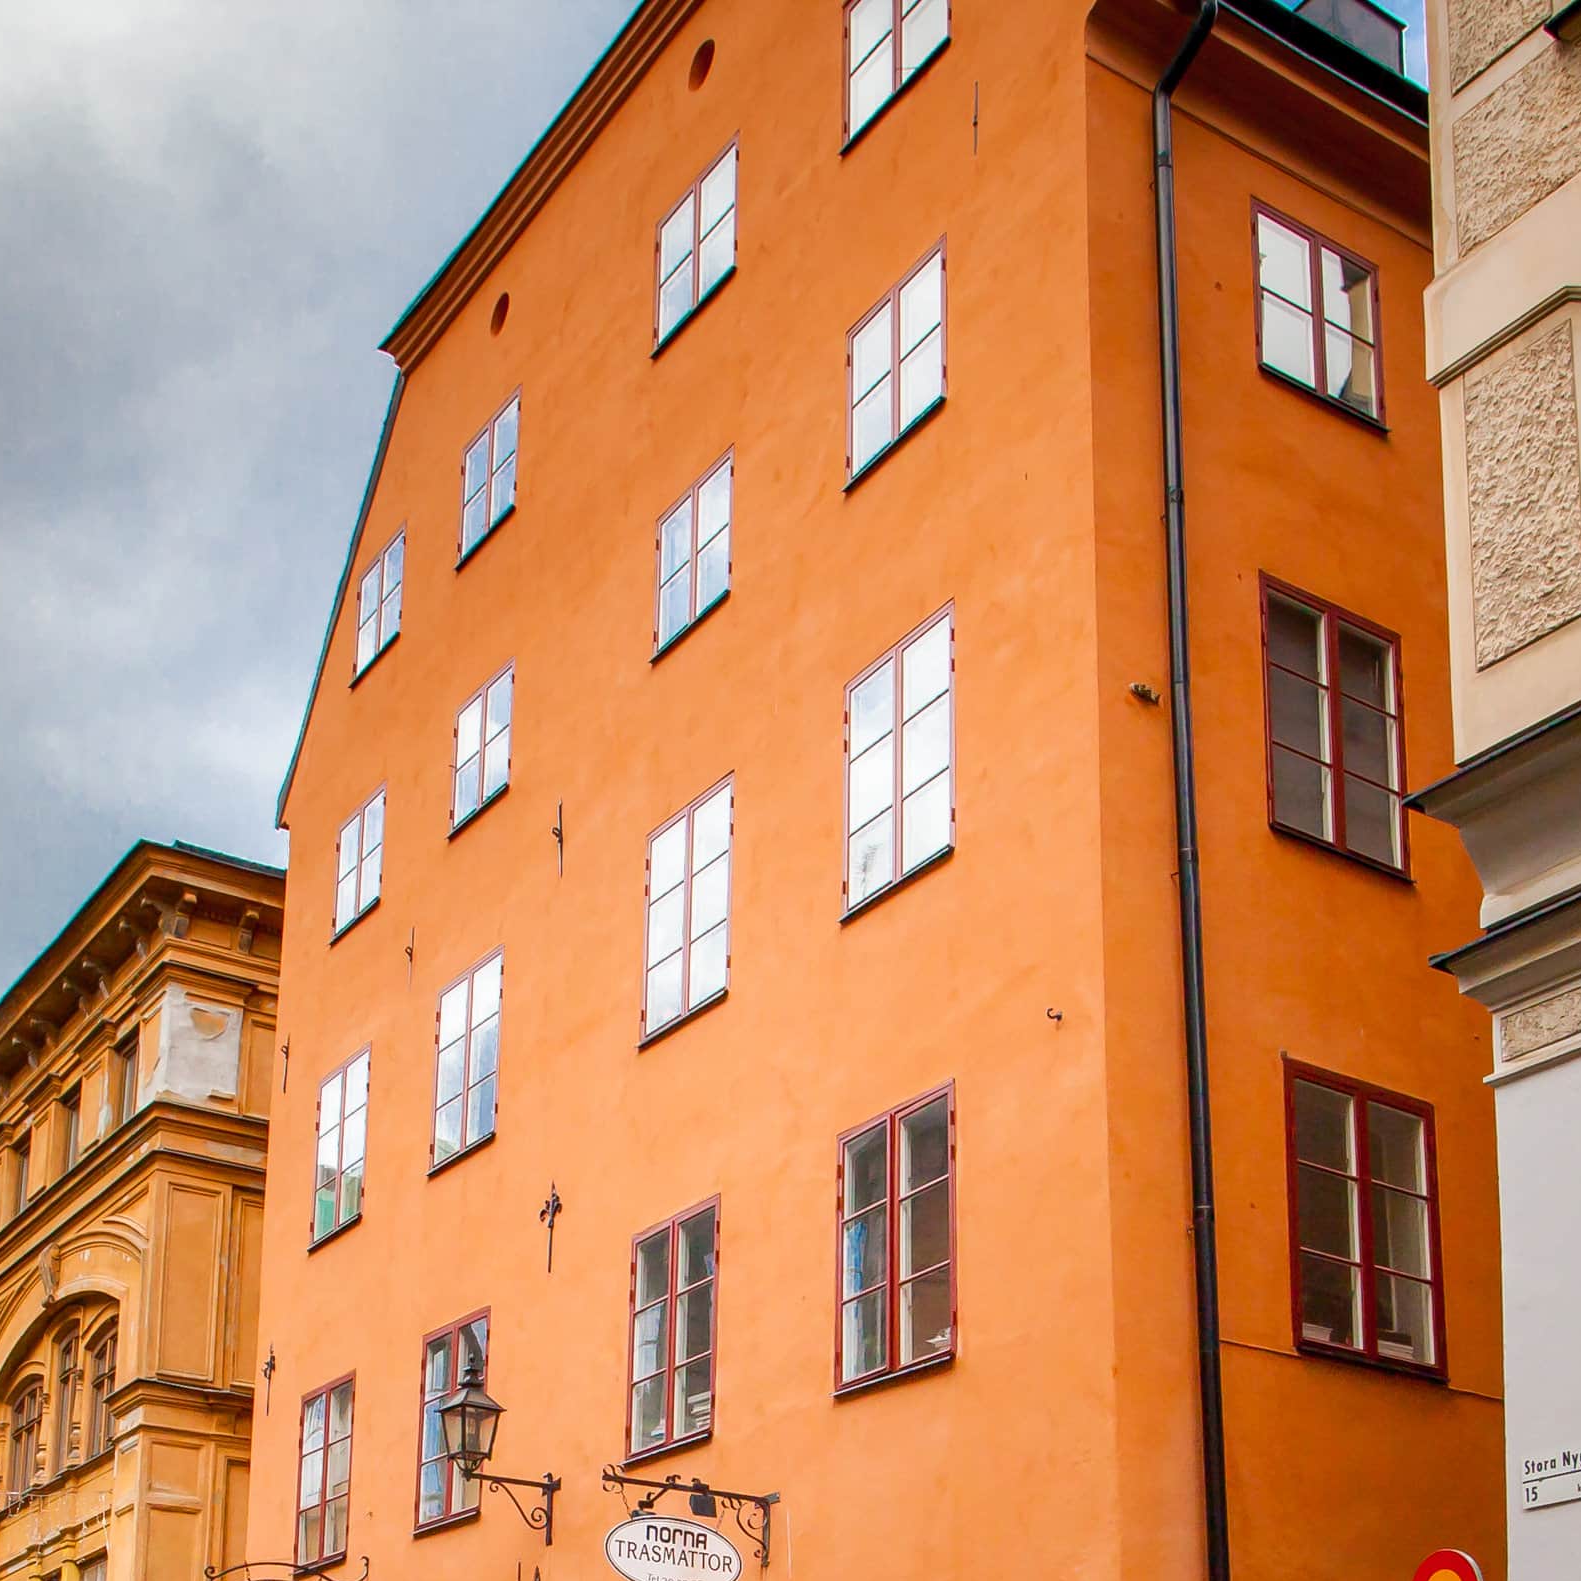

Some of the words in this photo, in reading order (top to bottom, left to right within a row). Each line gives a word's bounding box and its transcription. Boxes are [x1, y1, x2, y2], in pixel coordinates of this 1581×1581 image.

[1524, 1459, 1557, 1475] Stora
[1525, 1486, 1538, 1503] 15
[614, 1539, 733, 1573] TRASMATTOR
